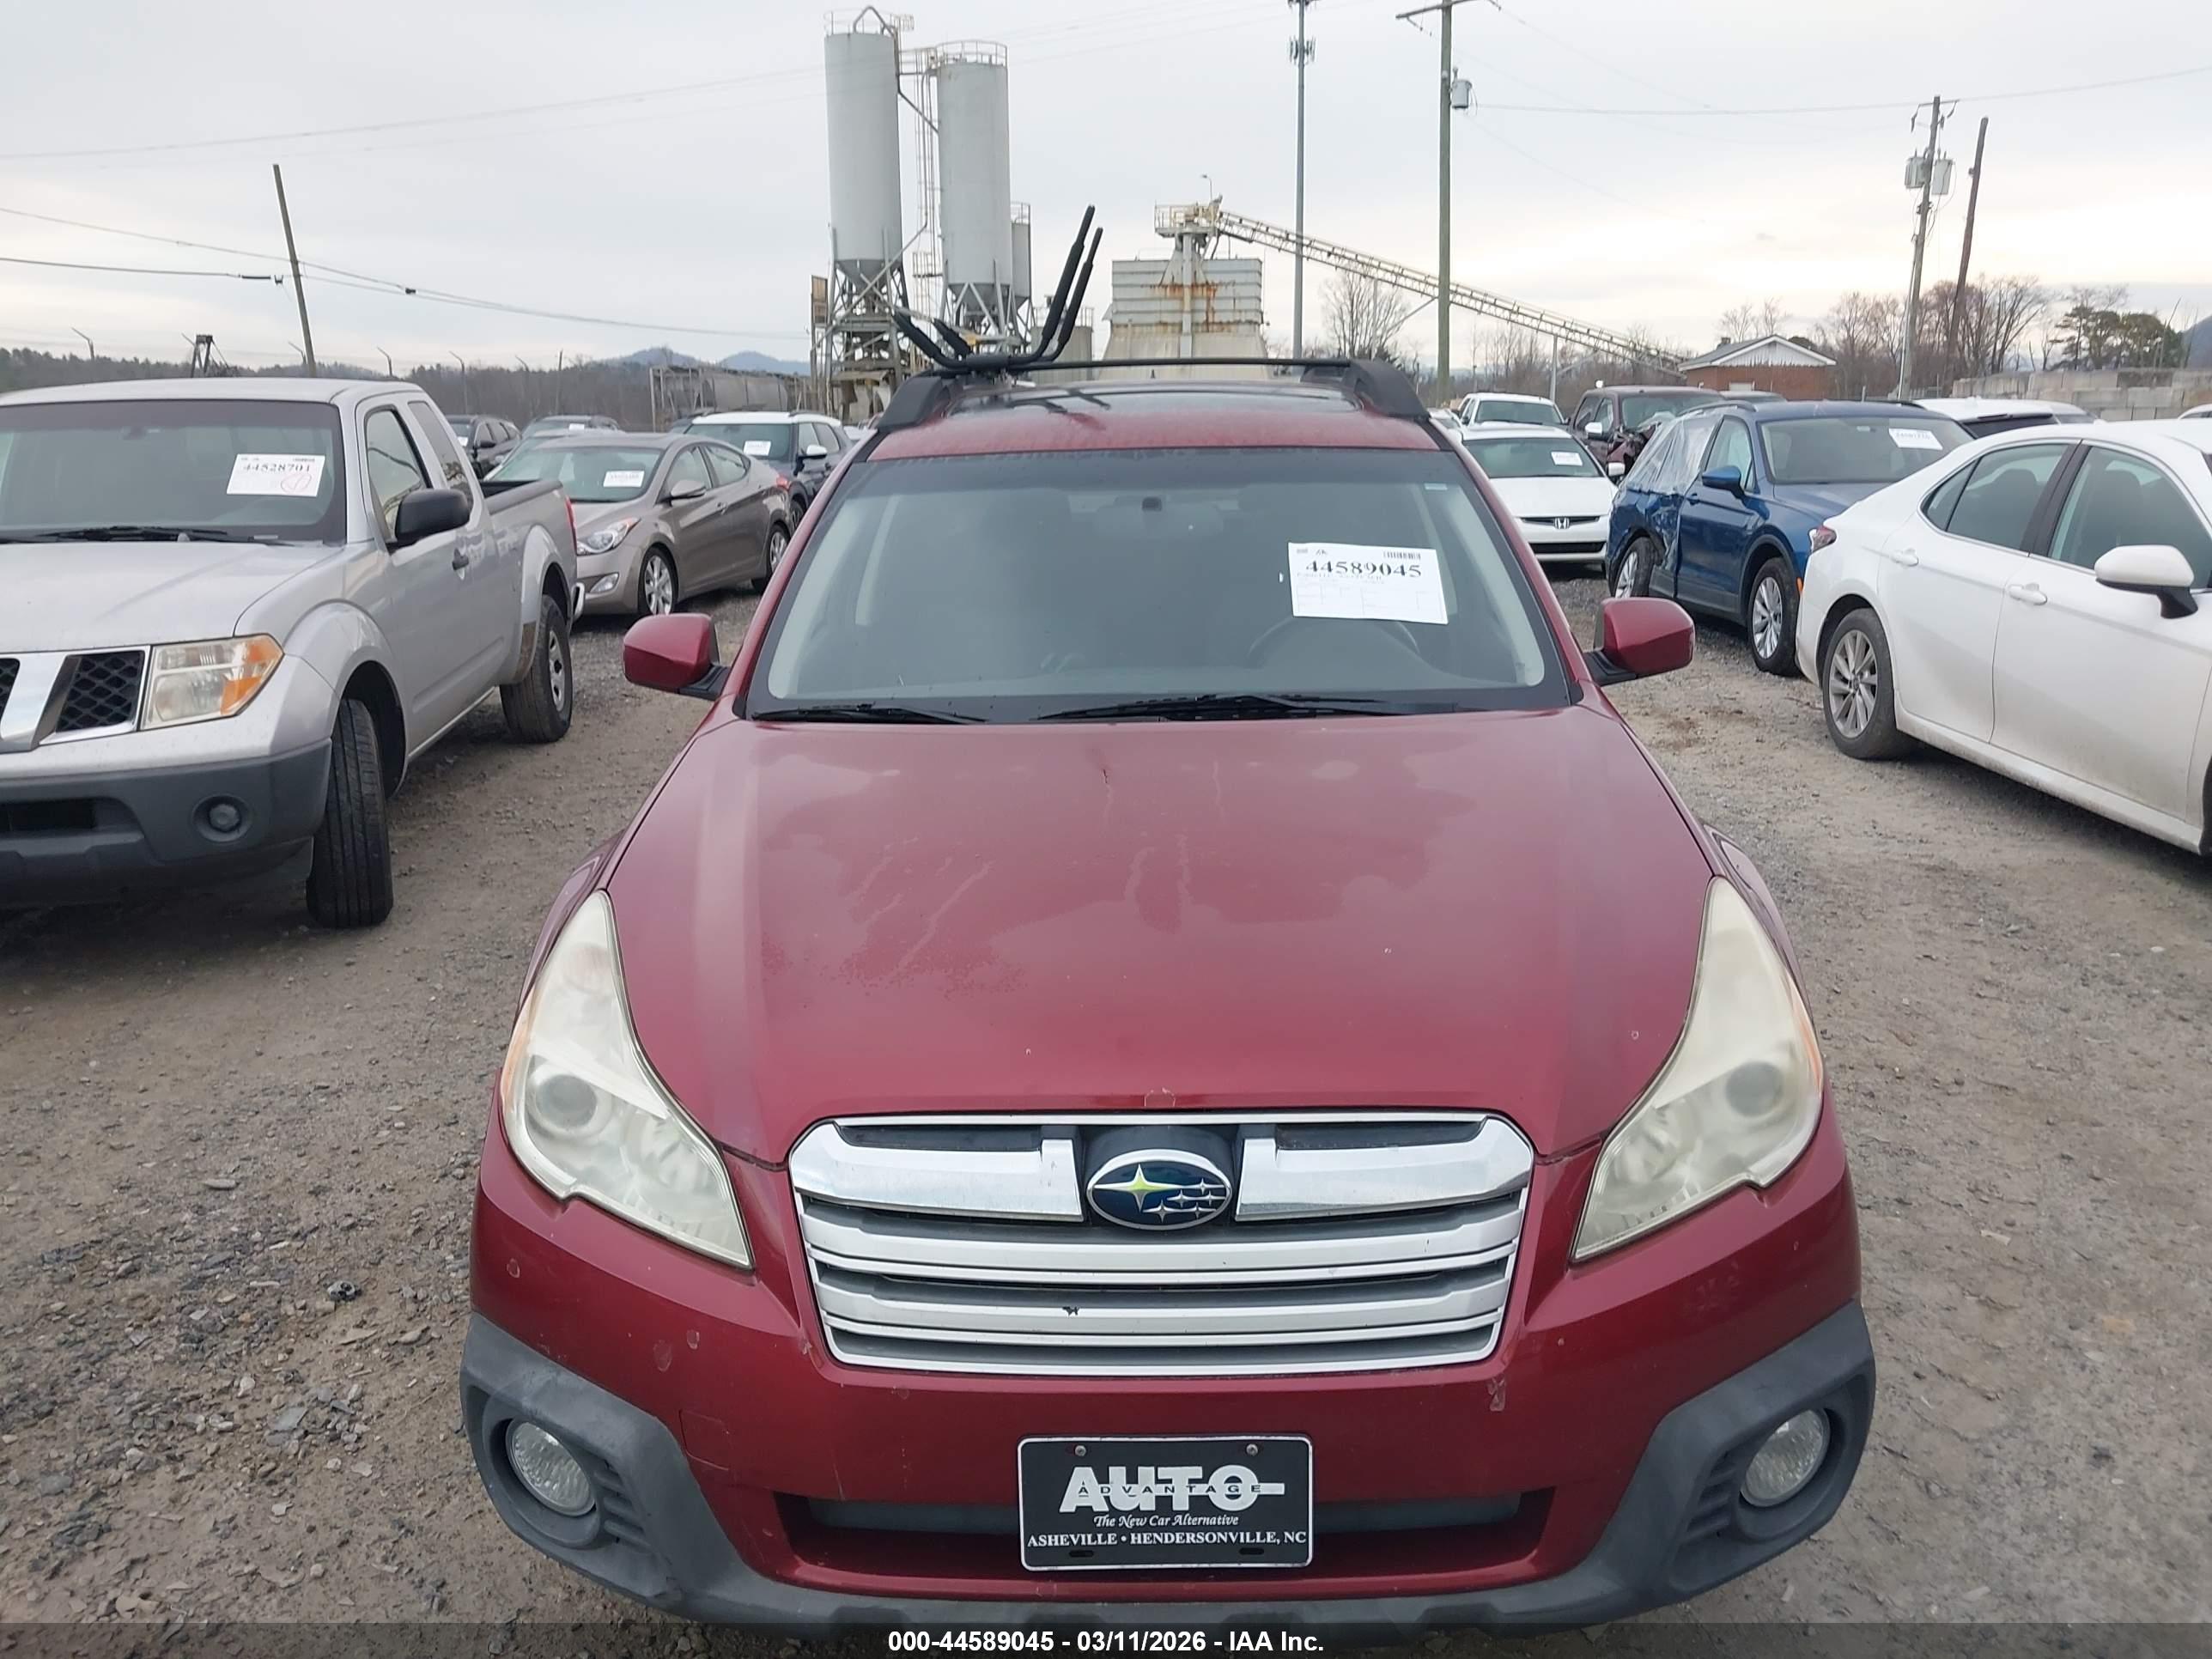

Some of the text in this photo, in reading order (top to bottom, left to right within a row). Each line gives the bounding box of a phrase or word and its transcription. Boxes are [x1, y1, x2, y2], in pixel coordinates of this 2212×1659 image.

[1305, 560, 1422, 578] 44589045
[1060, 1464, 1260, 1513] AUTO
[1078, 1483, 1261, 1495] ADVANTAGE
[1094, 1513, 1239, 1528] The New Car Alternative
[1027, 1531, 1307, 1547] ASHEVILLE HENDERSONVILLE, NC
